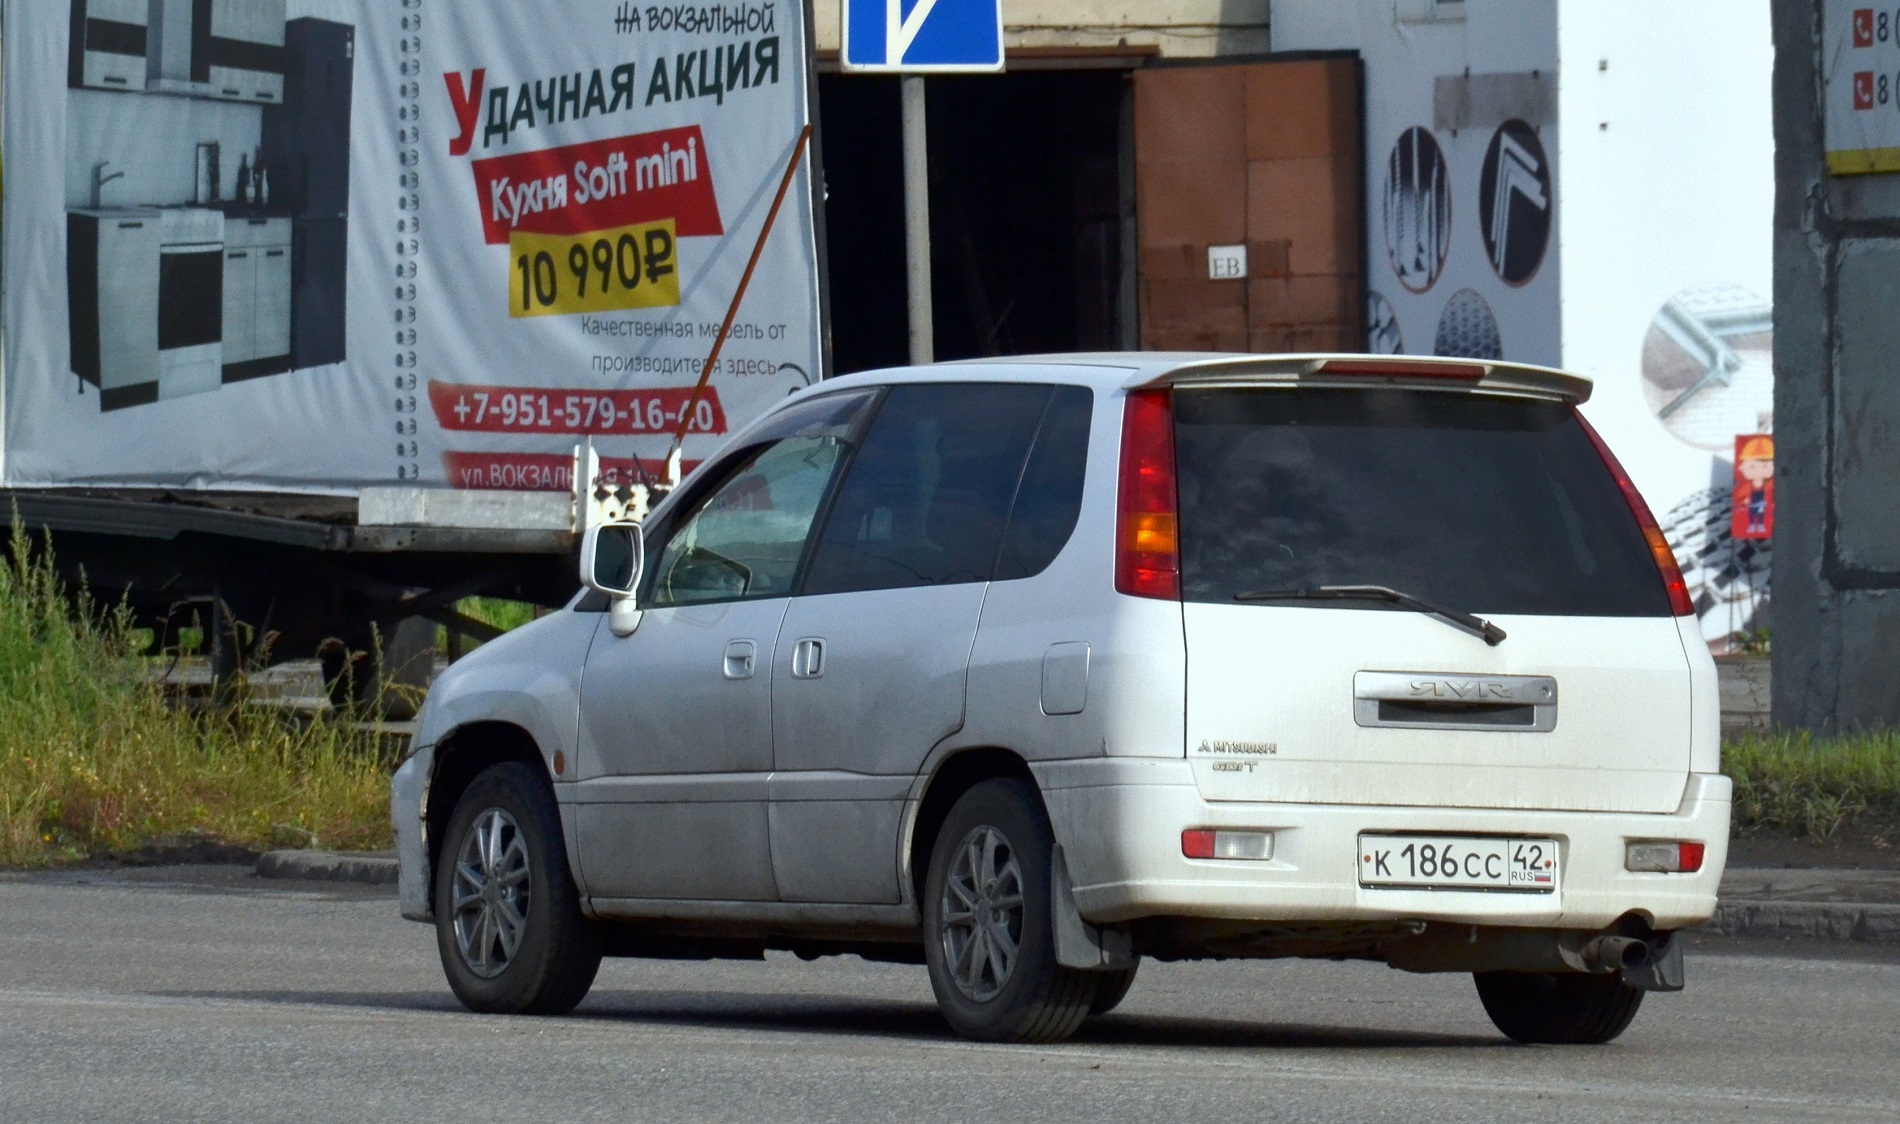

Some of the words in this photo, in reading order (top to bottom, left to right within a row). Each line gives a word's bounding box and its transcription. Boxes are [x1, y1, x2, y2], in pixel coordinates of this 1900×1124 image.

[615, 1, 641, 34] НА
[647, 2, 776, 36] ВОКЗАЛЬНОЙ
[443, 62, 637, 157] УДАЧНАЯ
[645, 36, 780, 107] АКЦИЯ
[490, 173, 568, 228] Кухня
[574, 151, 629, 205] Soft
[635, 136, 698, 192] mini
[517, 250, 558, 311] 10
[581, 315, 694, 338] Качественная
[768, 323, 787, 340] от
[727, 358, 777, 377] здесь
[1213, 740, 1278, 755] MITSUBISHI
[1513, 843, 1543, 871] 42
[1511, 870, 1534, 882] RUS
